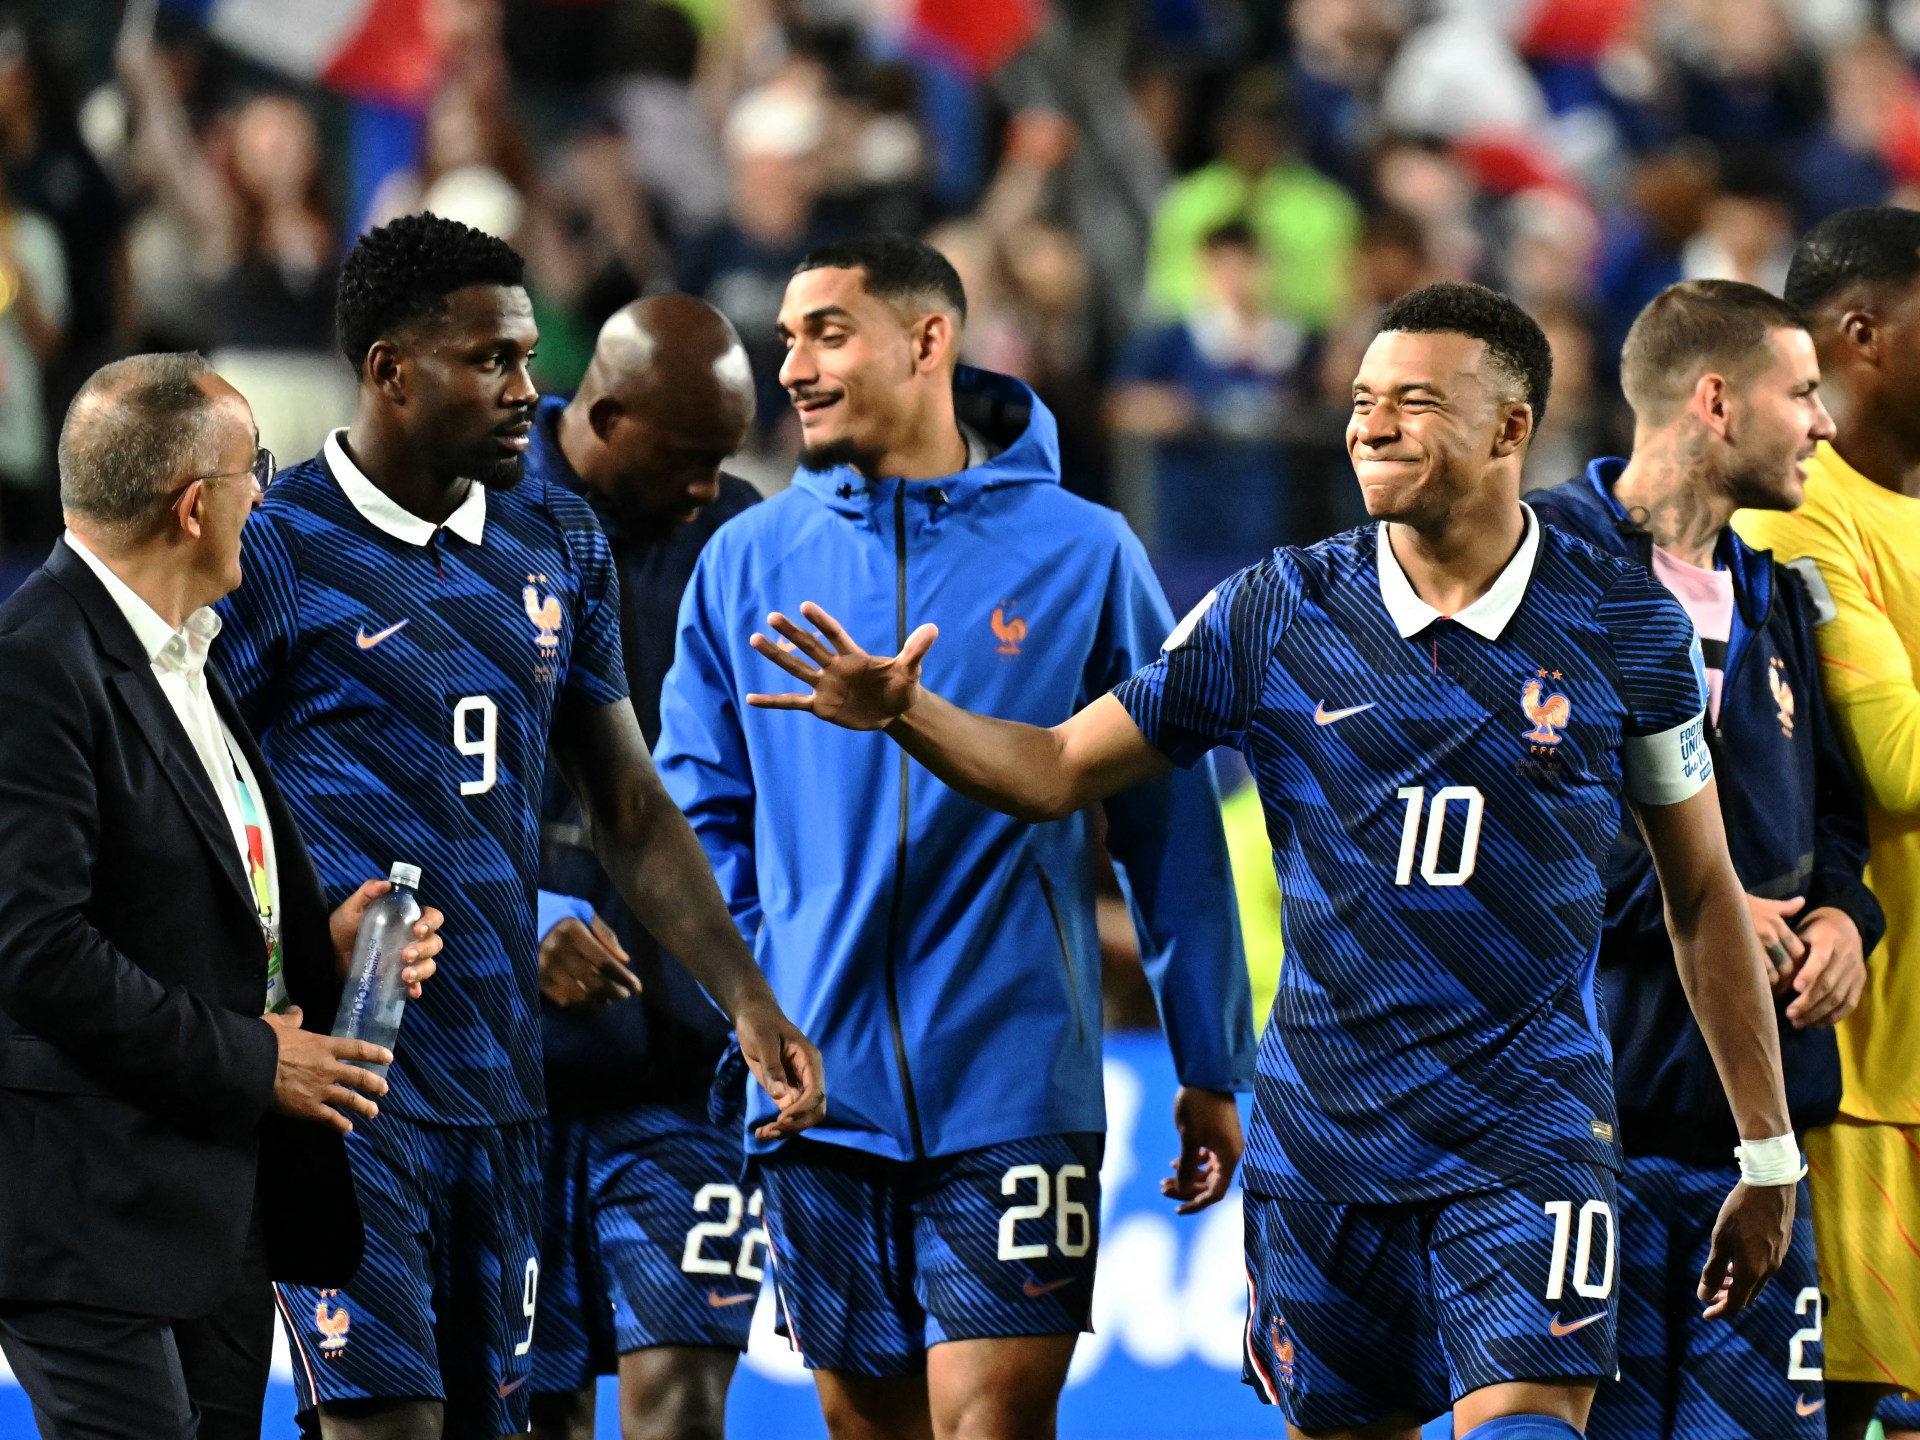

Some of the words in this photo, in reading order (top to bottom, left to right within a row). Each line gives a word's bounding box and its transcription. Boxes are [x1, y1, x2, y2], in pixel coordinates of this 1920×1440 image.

[453, 695, 498, 796] 9
[1530, 745, 1556, 756] FFF
[1394, 785, 1486, 887] 10
[997, 1164, 1091, 1261] 26
[1543, 1199, 1617, 1300] 10
[514, 1256, 539, 1357] 9
